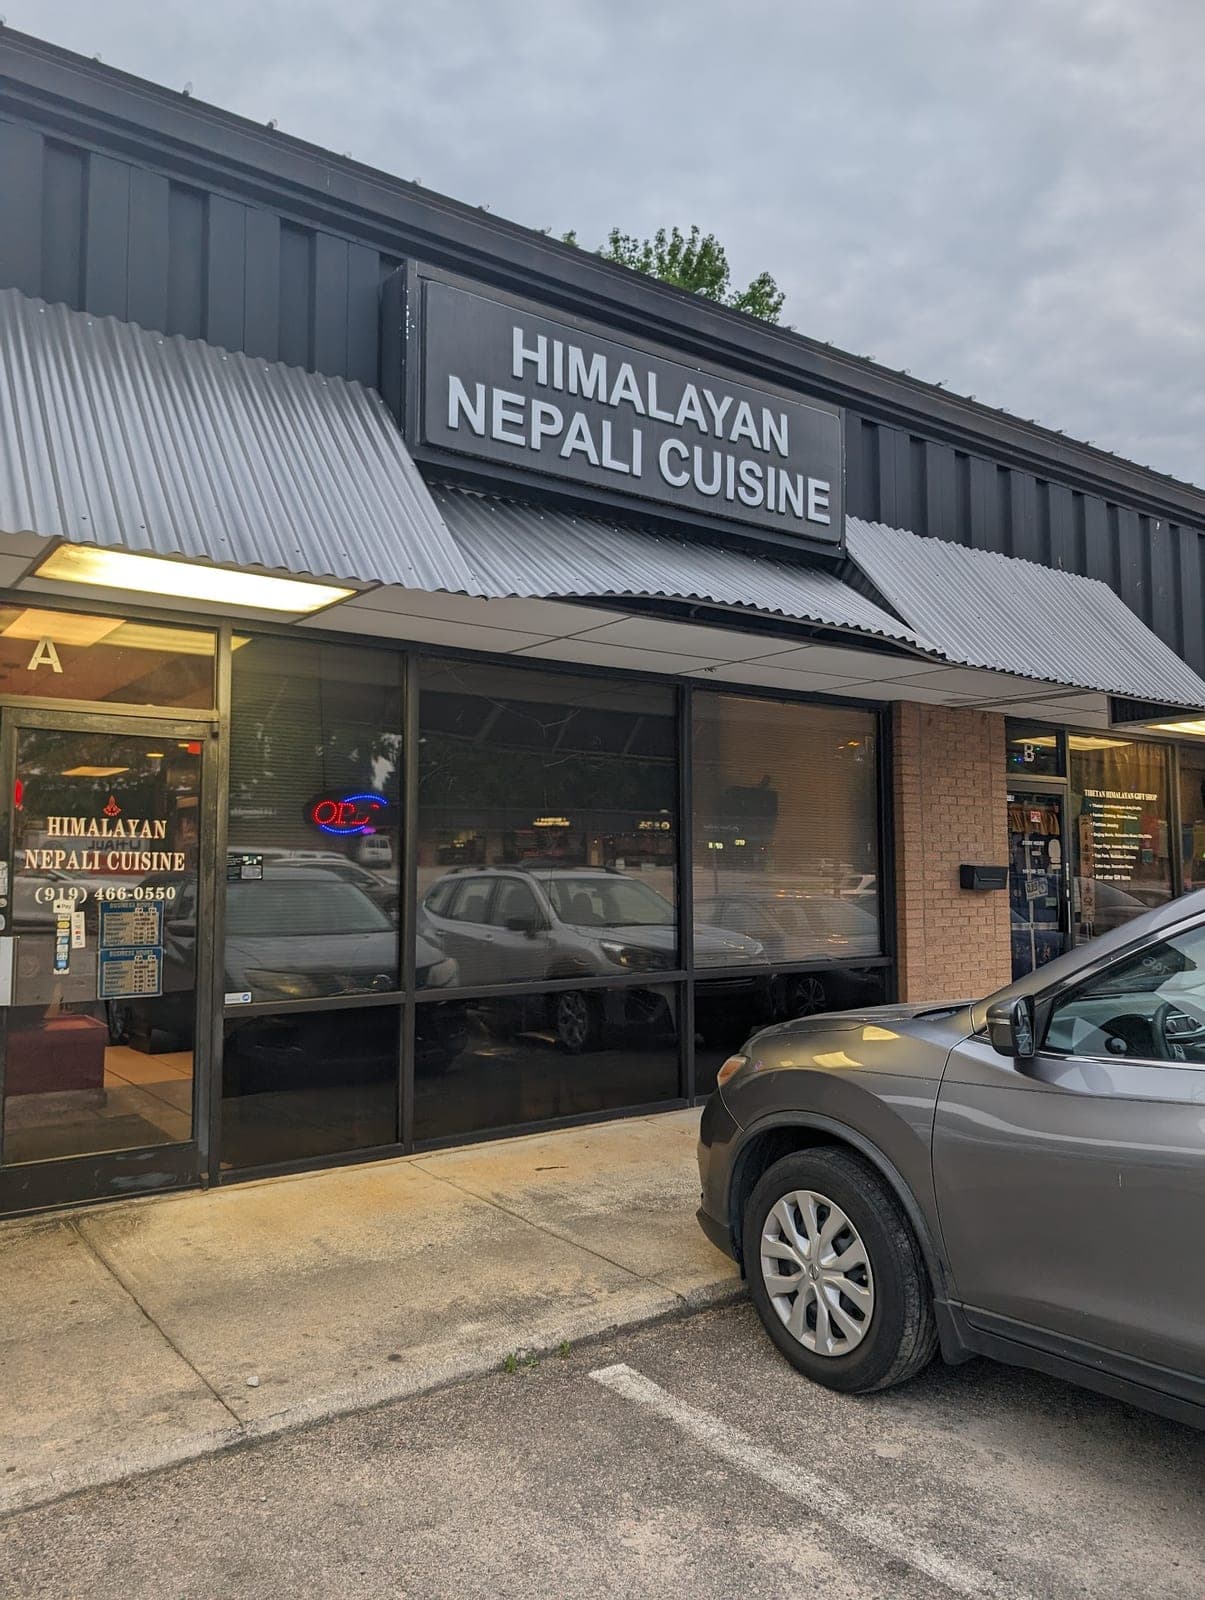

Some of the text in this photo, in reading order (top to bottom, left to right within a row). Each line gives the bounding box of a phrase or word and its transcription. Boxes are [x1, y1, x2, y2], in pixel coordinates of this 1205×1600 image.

[512, 326, 789, 457] HIMALAYAN
[448, 375, 831, 524] NEPALI CUISINE
[27, 637, 63, 673] A
[1024, 744, 1036, 763] B
[1105, 791, 1134, 799] HIMALAYAN
[47, 816, 167, 839] HIMALAYAN
[24, 849, 185, 871] NEPALI CUISINE
[35, 887, 176, 904] (919) 466-0550
